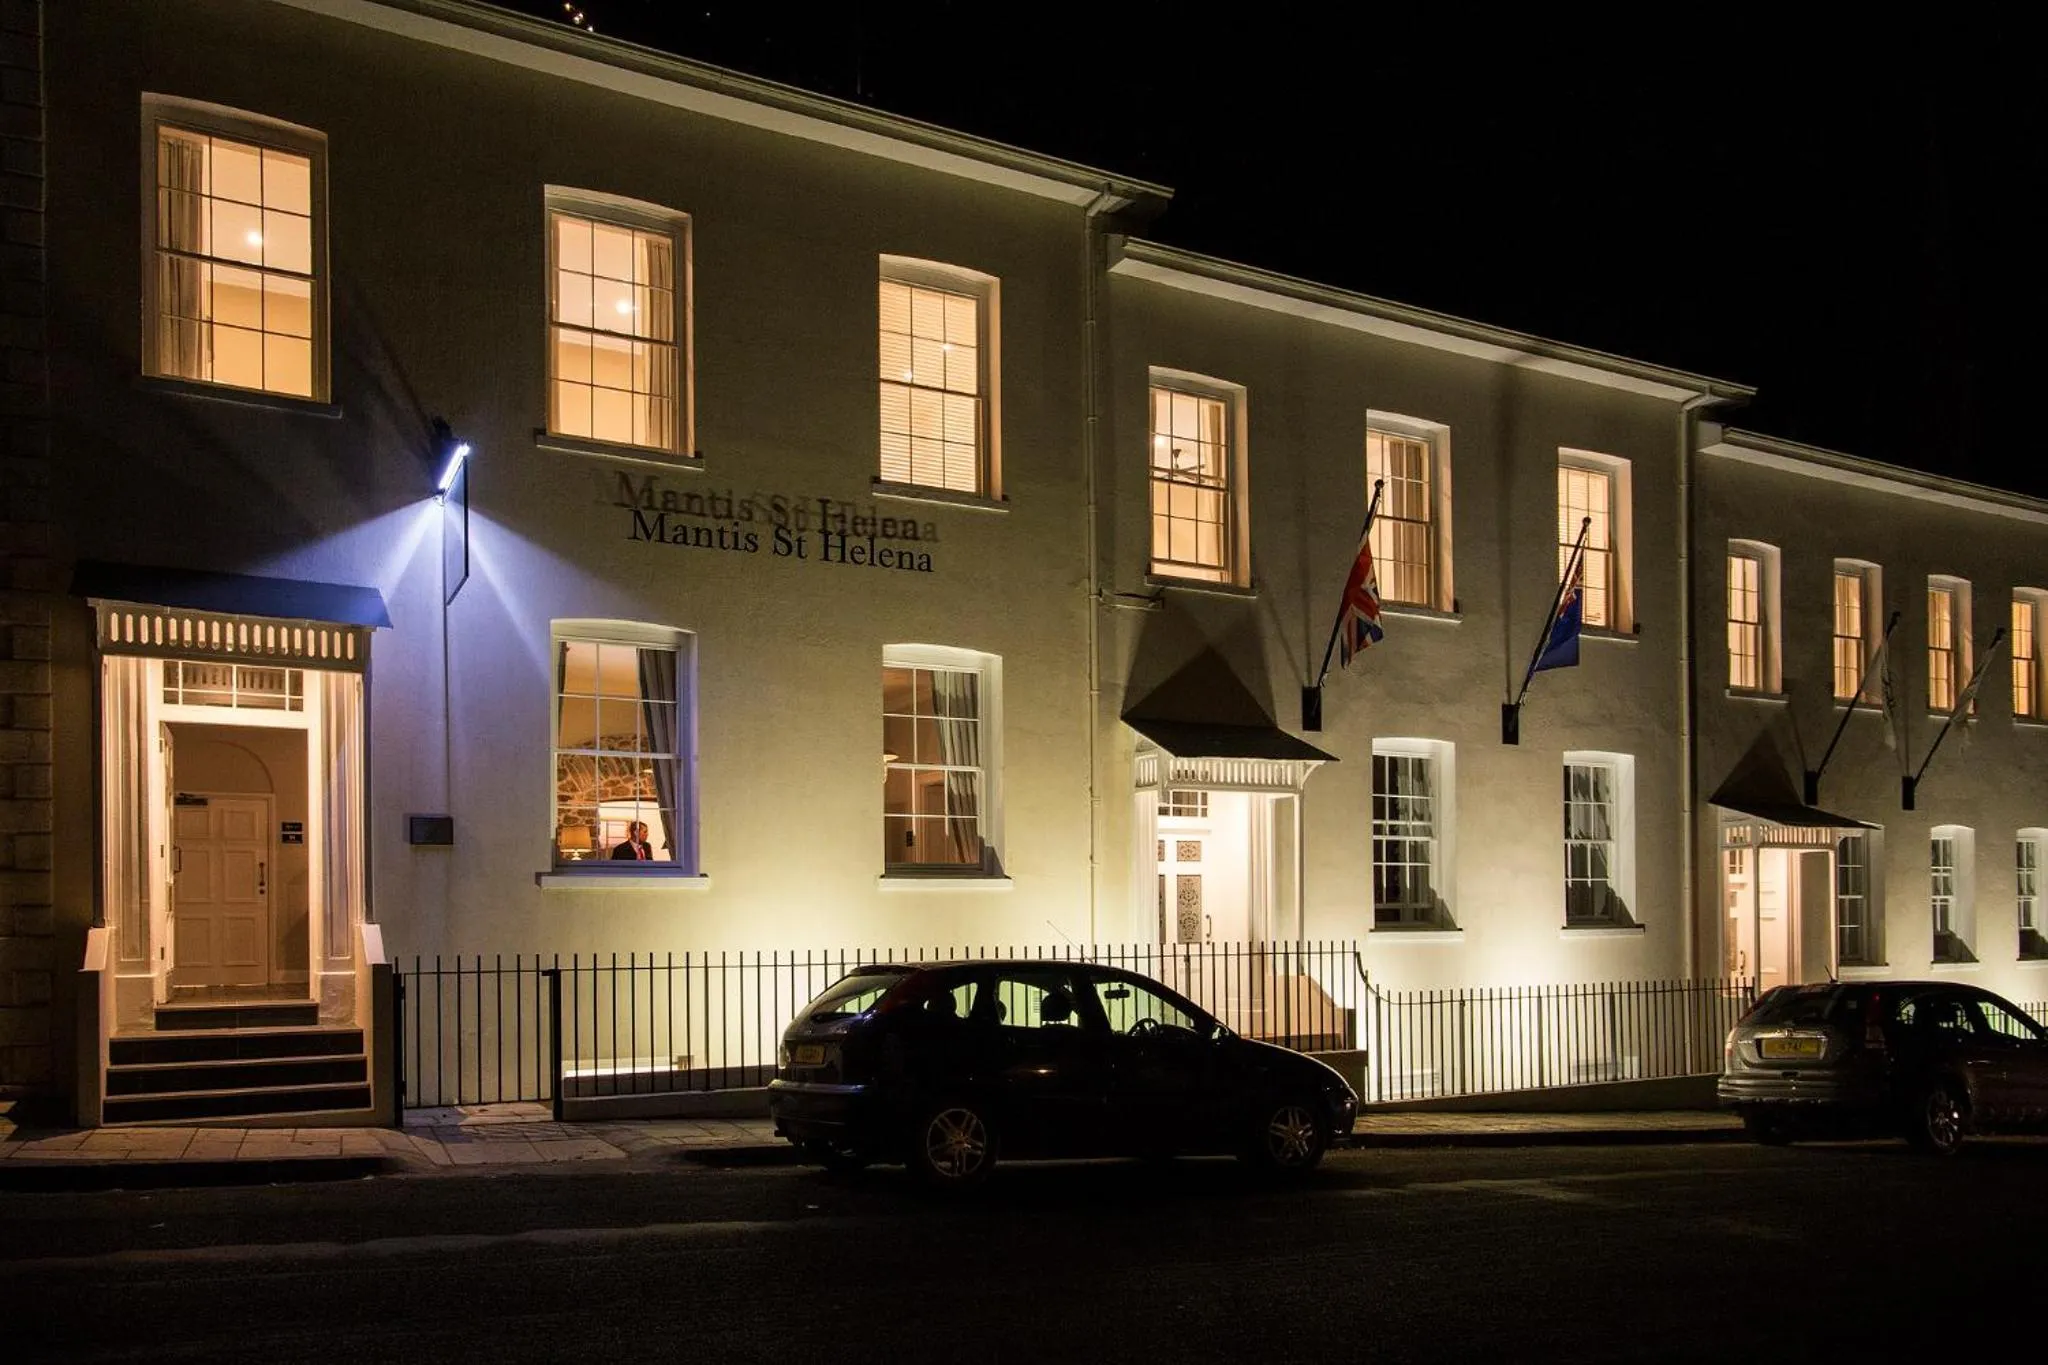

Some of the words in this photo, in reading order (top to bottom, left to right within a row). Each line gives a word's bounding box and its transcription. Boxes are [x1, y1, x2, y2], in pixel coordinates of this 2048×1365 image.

[627, 508, 759, 553] Mantis
[772, 524, 808, 559] St
[819, 531, 935, 573] Helena
